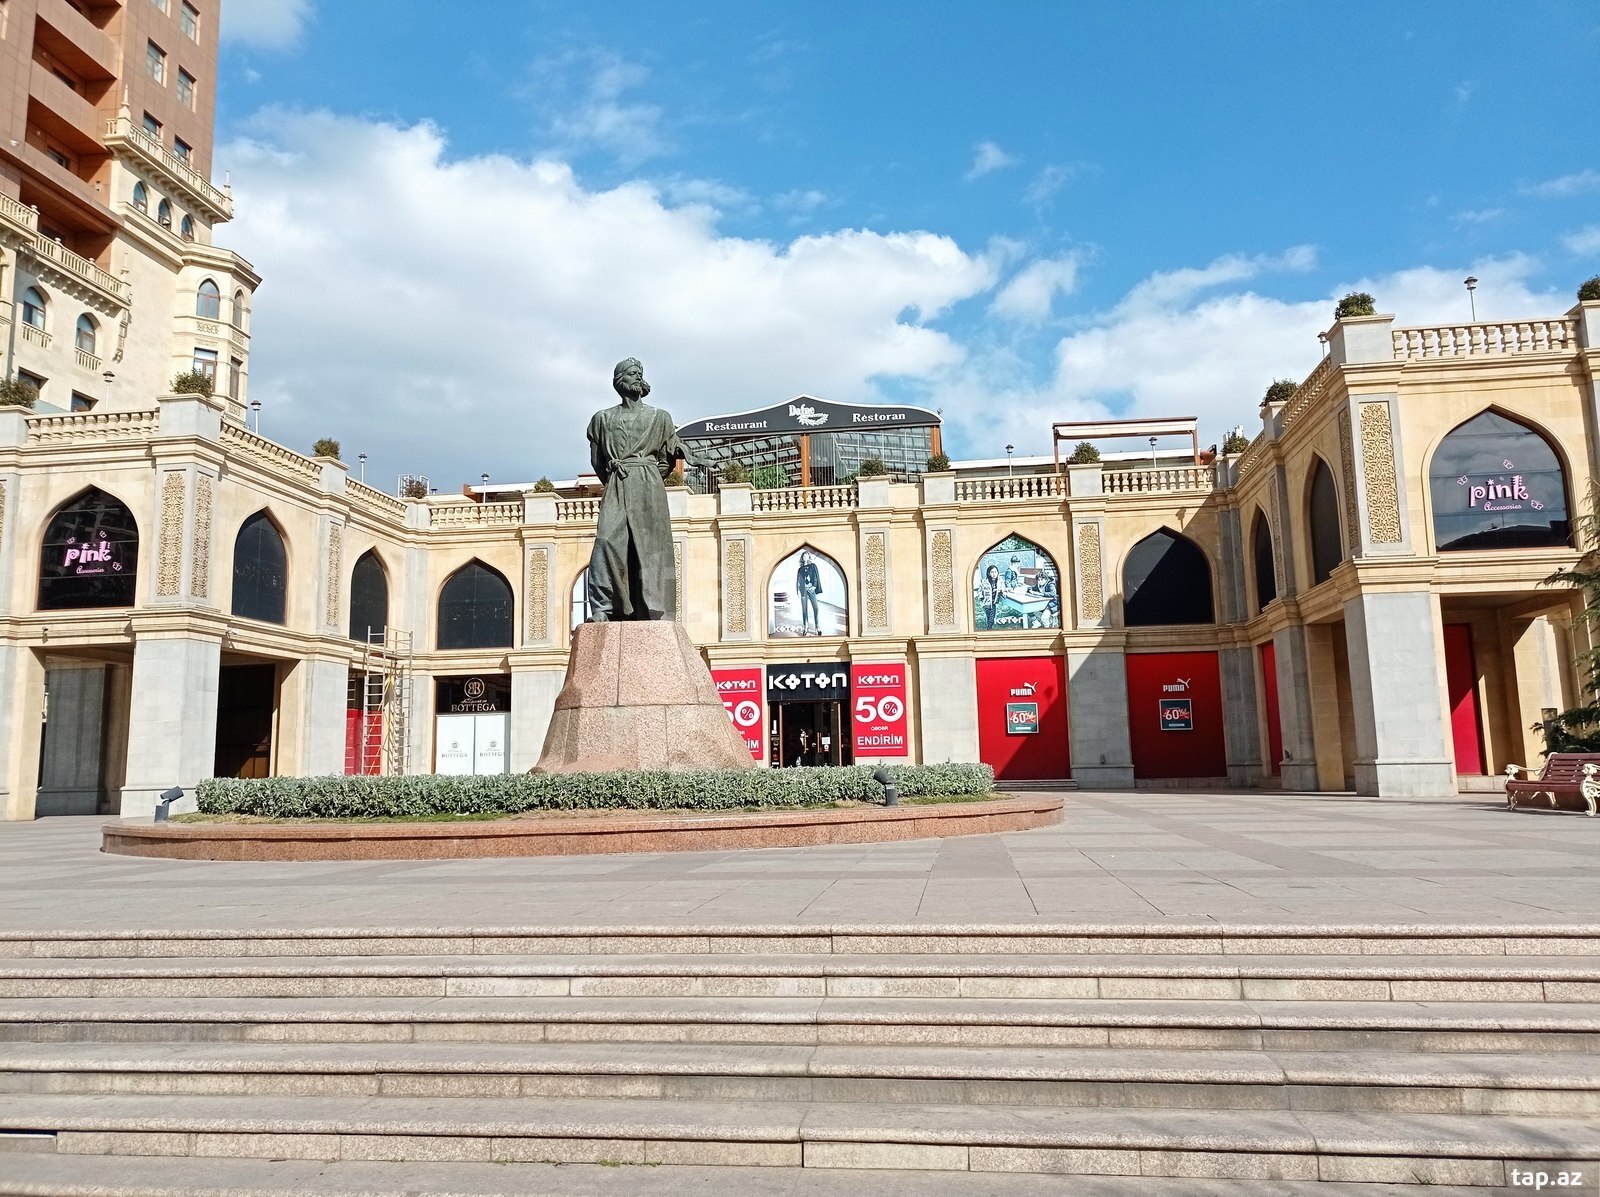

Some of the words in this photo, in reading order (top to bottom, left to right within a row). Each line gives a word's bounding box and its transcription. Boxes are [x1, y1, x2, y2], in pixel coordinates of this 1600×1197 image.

[788, 403, 815, 417] Dafne
[852, 413, 906, 423] Restoran
[705, 420, 768, 432] Restaurant
[1470, 474, 1529, 507] pink
[1483, 501, 1522, 512] Accessories
[63, 540, 112, 567] pink
[716, 680, 756, 690] KOTON
[768, 672, 847, 690] KOTON
[858, 675, 899, 685] KOTON
[1010, 688, 1033, 696] PUMA
[1163, 684, 1185, 692] PUMA
[451, 703, 497, 712] BOTTEGA
[855, 695, 904, 723] 50%
[857, 734, 903, 746] ENDİRİM
